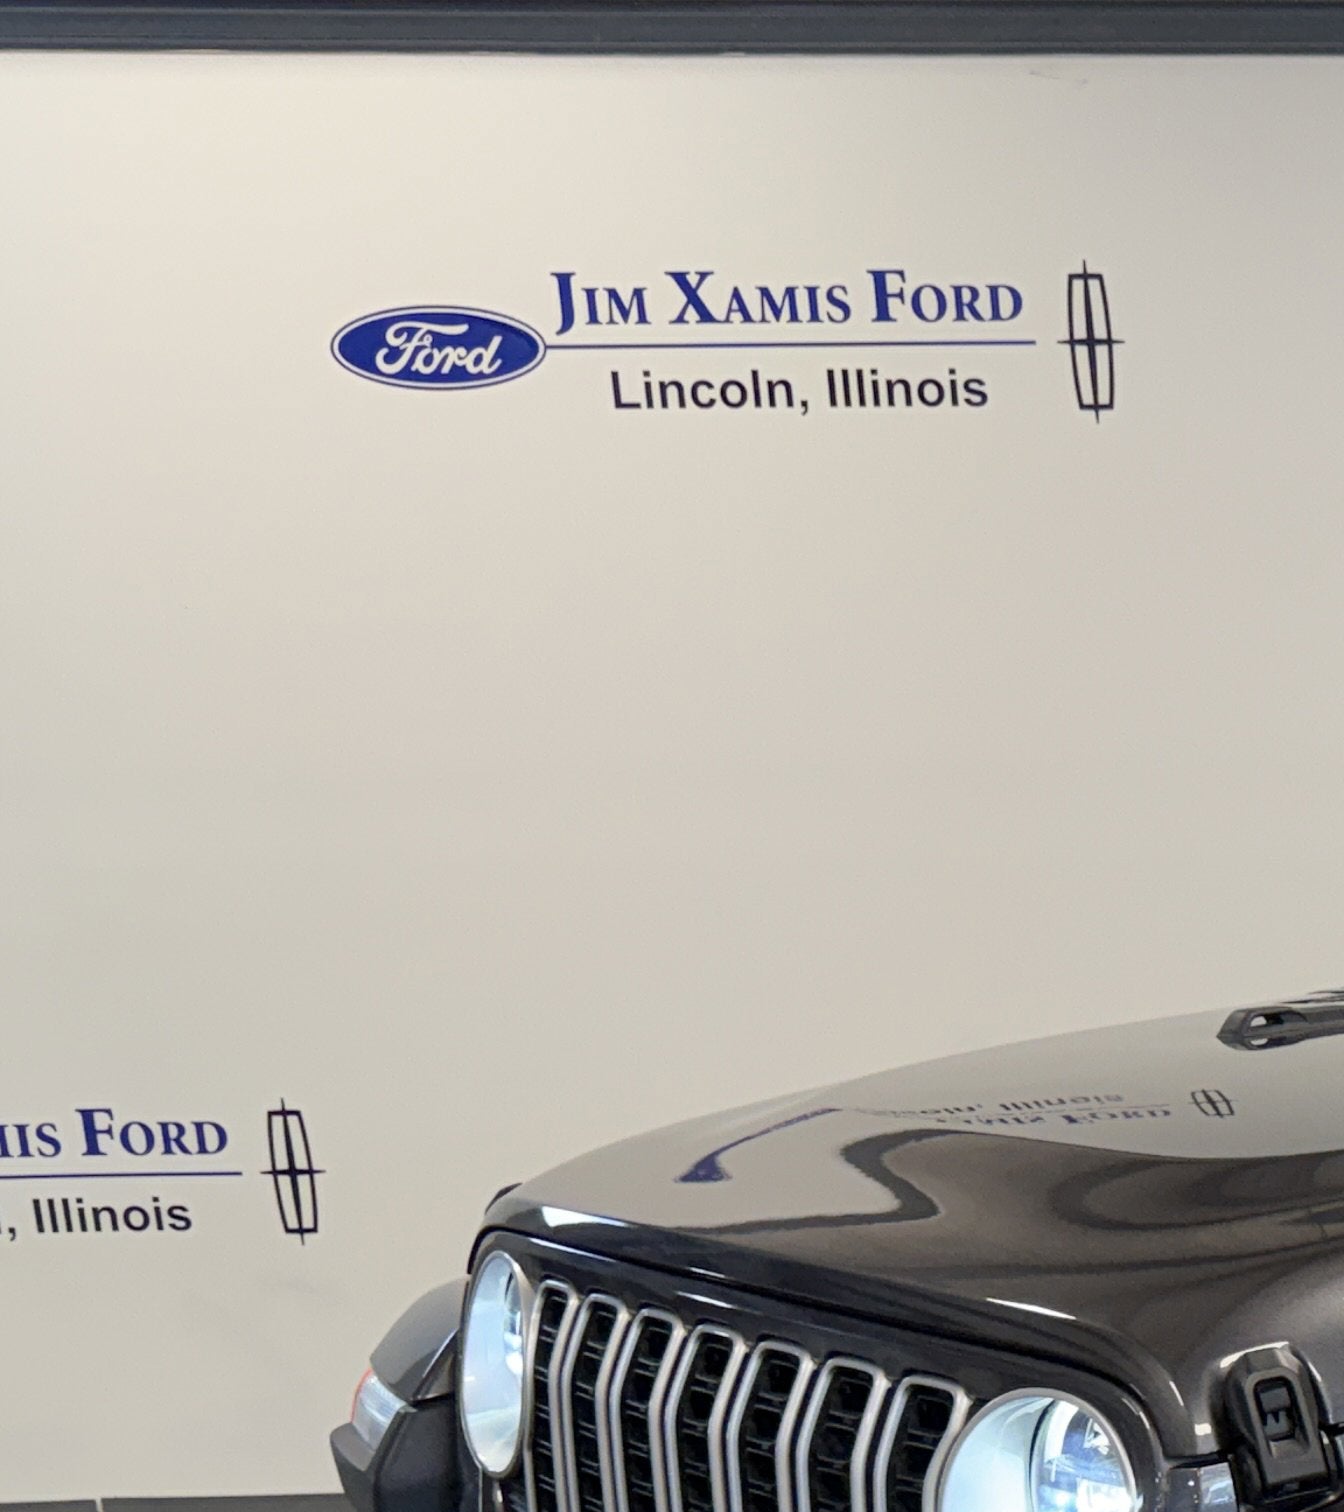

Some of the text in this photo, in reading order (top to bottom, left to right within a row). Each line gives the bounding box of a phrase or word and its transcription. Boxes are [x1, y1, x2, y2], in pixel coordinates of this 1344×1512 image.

[611, 368, 989, 417] Lincoln, Illinois
[32, 1196, 193, 1235] Illinois
